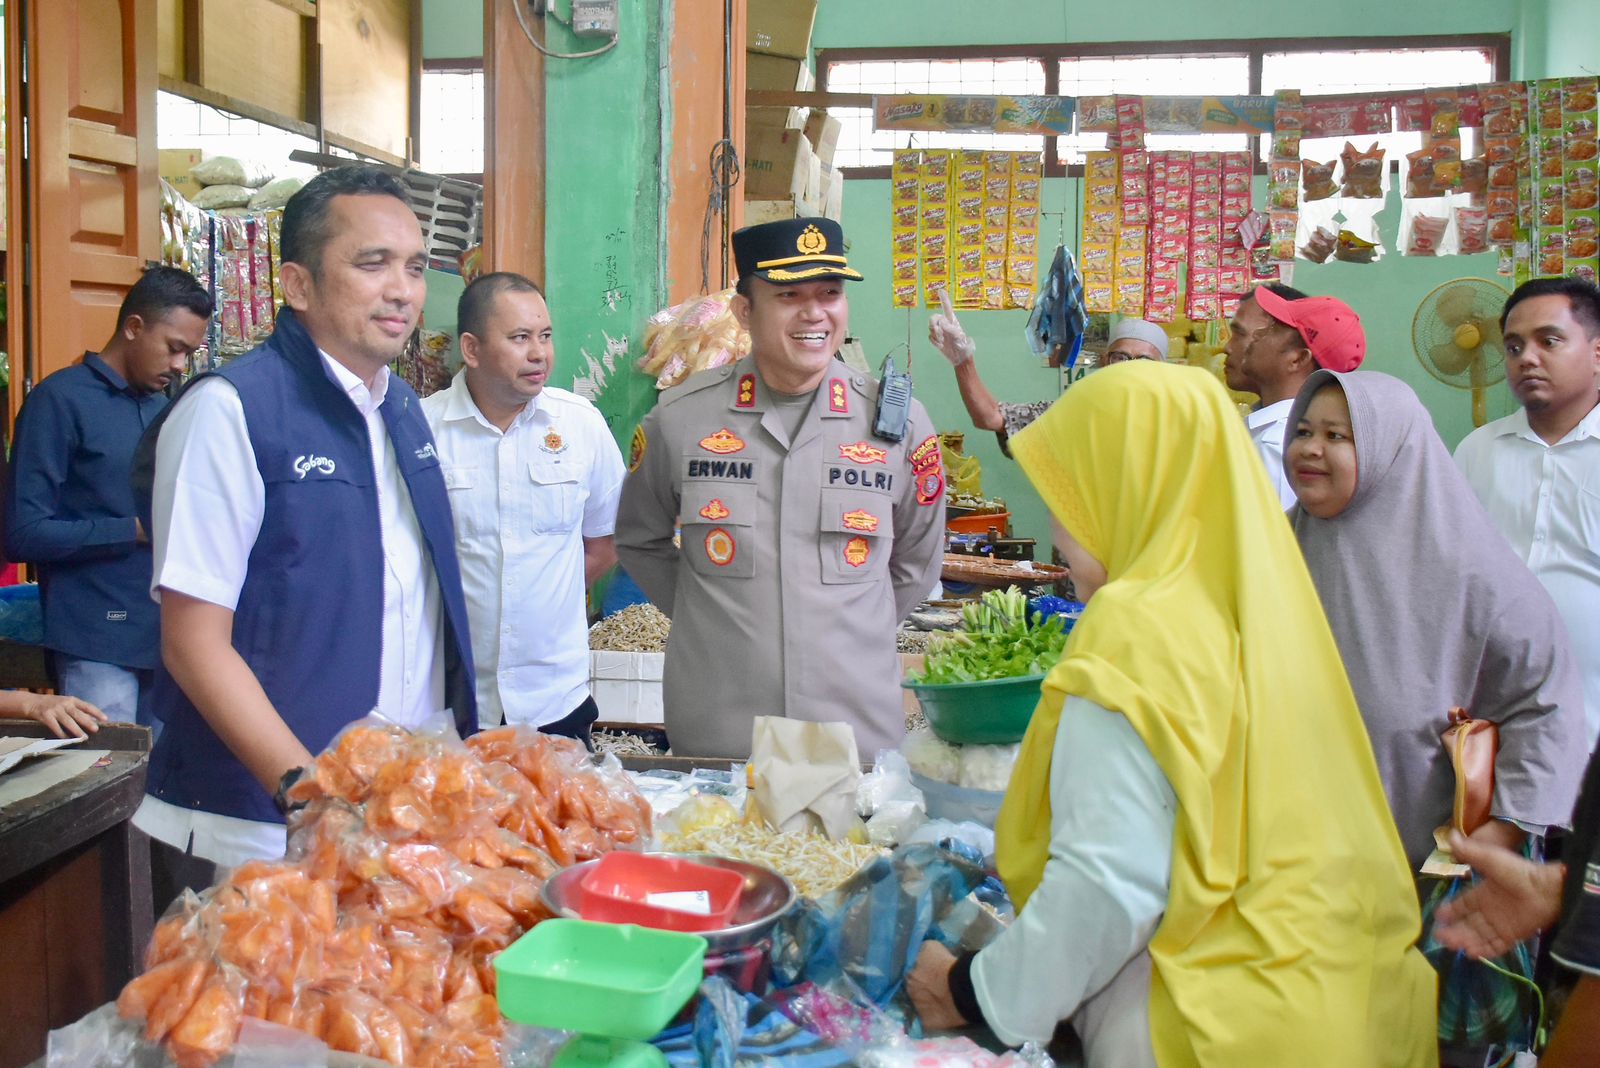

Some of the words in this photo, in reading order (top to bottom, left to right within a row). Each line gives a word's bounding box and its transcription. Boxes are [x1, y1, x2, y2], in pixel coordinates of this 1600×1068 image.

[294, 454, 336, 480] Sabang
[688, 460, 753, 479] ERWAN
[829, 467, 893, 491] POLRI
